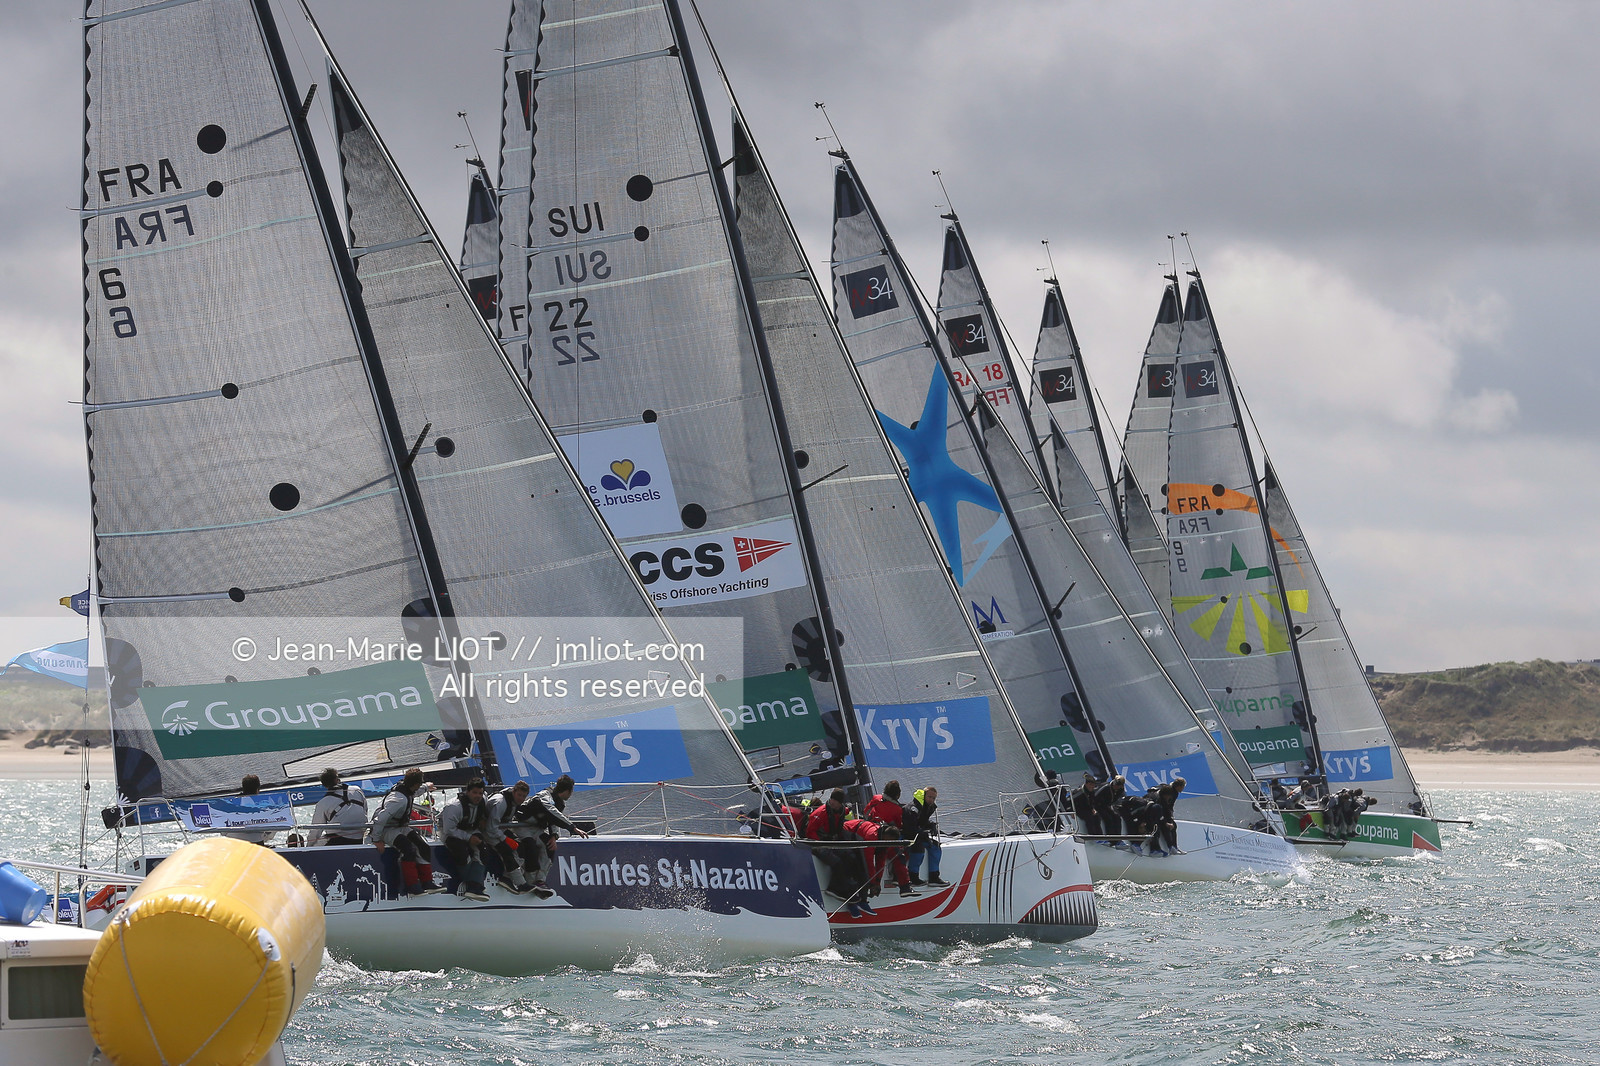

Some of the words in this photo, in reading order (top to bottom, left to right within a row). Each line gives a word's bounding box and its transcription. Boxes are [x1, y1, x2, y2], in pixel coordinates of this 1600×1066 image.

[97, 158, 182, 201] FRA
[548, 202, 604, 237] SUI
[99, 268, 126, 300] 6
[544, 298, 592, 331] 22
[983, 363, 1003, 381] 18
[603, 489, 661, 507] .brussels
[1177, 496, 1211, 513] FRA
[629, 542, 725, 585] CCS
[650, 591, 668, 601] iss
[670, 586, 718, 599] Offshore
[719, 577, 769, 594] Yachting
[204, 686, 422, 729] Groupama
[854, 708, 954, 764] Krys
[507, 730, 641, 783] Krys
[1324, 752, 1372, 780] Krys
[195, 815, 212, 825] bleu
[557, 855, 650, 886] Nantes
[658, 857, 779, 892] St-Nazaire
